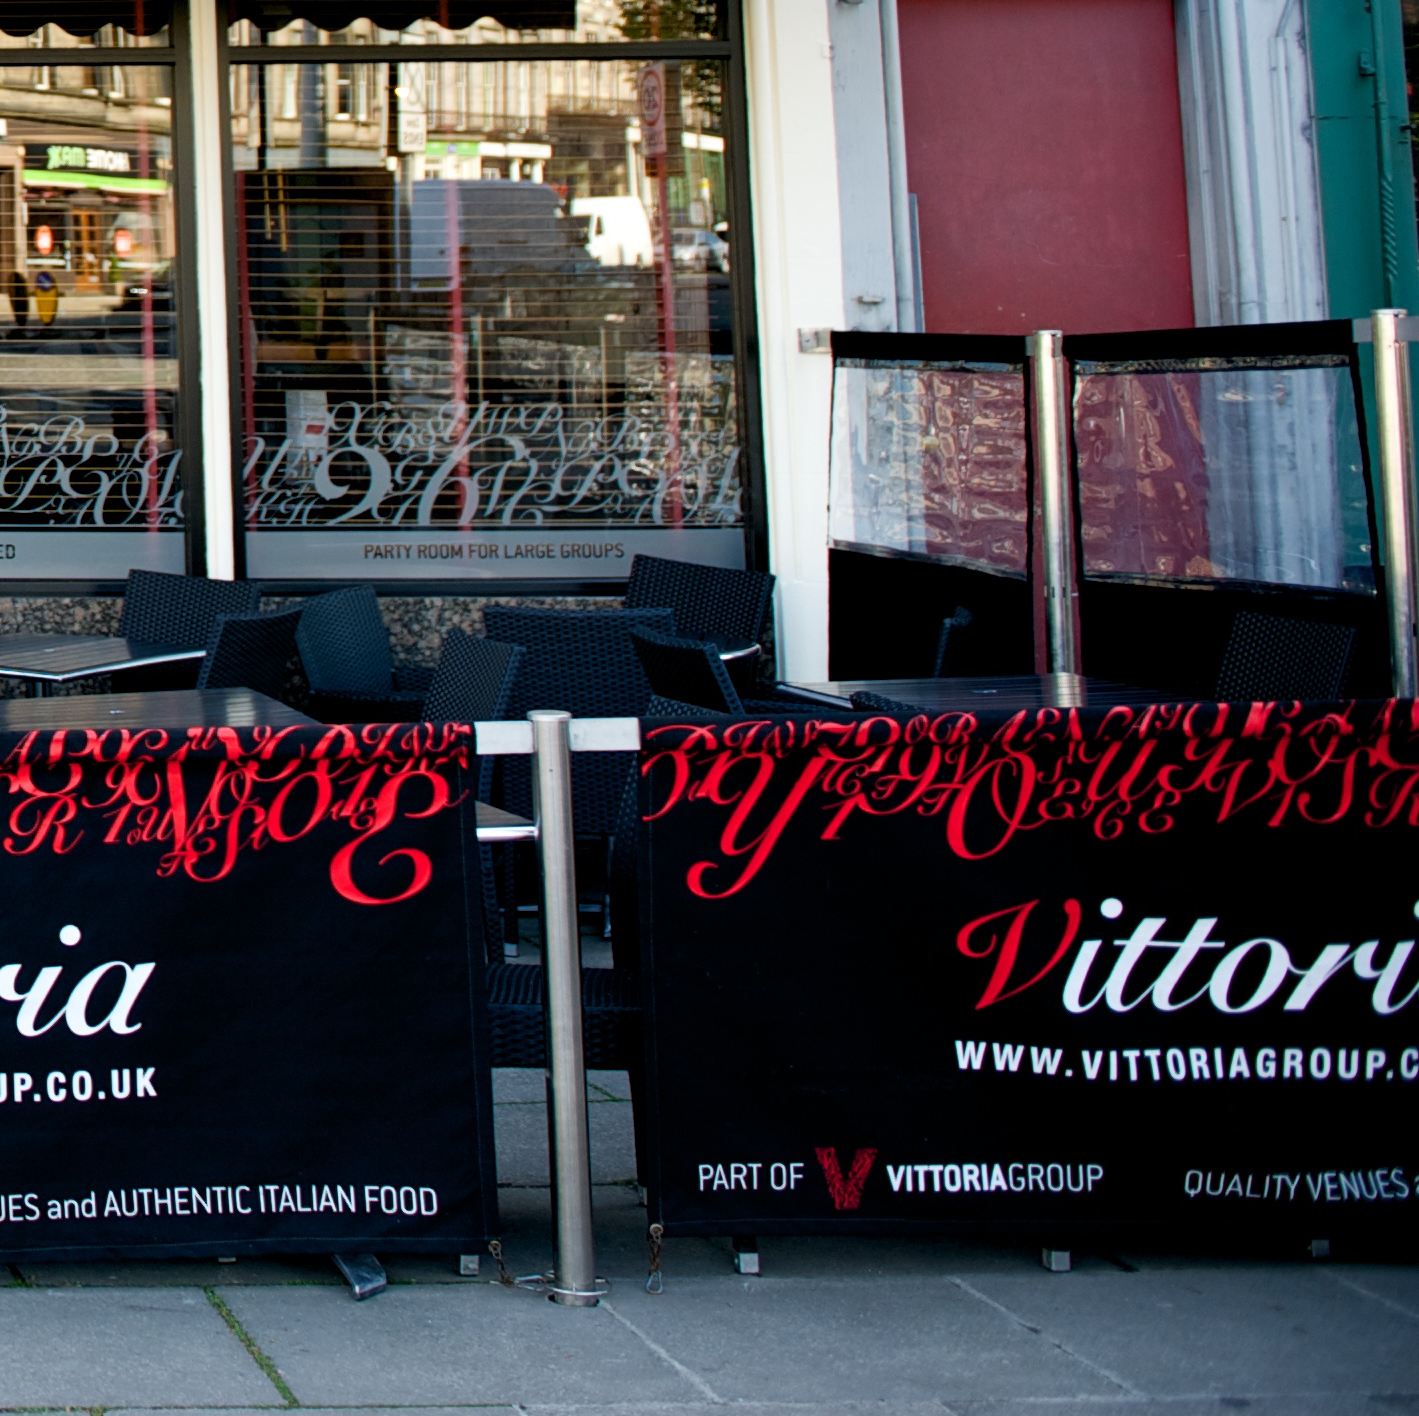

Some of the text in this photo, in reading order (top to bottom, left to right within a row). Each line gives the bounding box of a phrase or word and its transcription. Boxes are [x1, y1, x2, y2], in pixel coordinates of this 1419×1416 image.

[363, 542, 625, 559] PARTY ROOM FOR LARGE GROUPS
[698, 1163, 762, 1192] PART
[770, 1162, 804, 1191] OF
[886, 1163, 1104, 1192] VITTORIAGROUP
[1185, 1170, 1300, 1199] QUALITY
[1306, 1169, 1410, 1201] VENUES
[47, 1191, 97, 1220] and
[104, 1185, 252, 1217] AUTHENTIC
[259, 1185, 356, 1213] ITALIAN
[364, 1185, 438, 1216] FOOD
